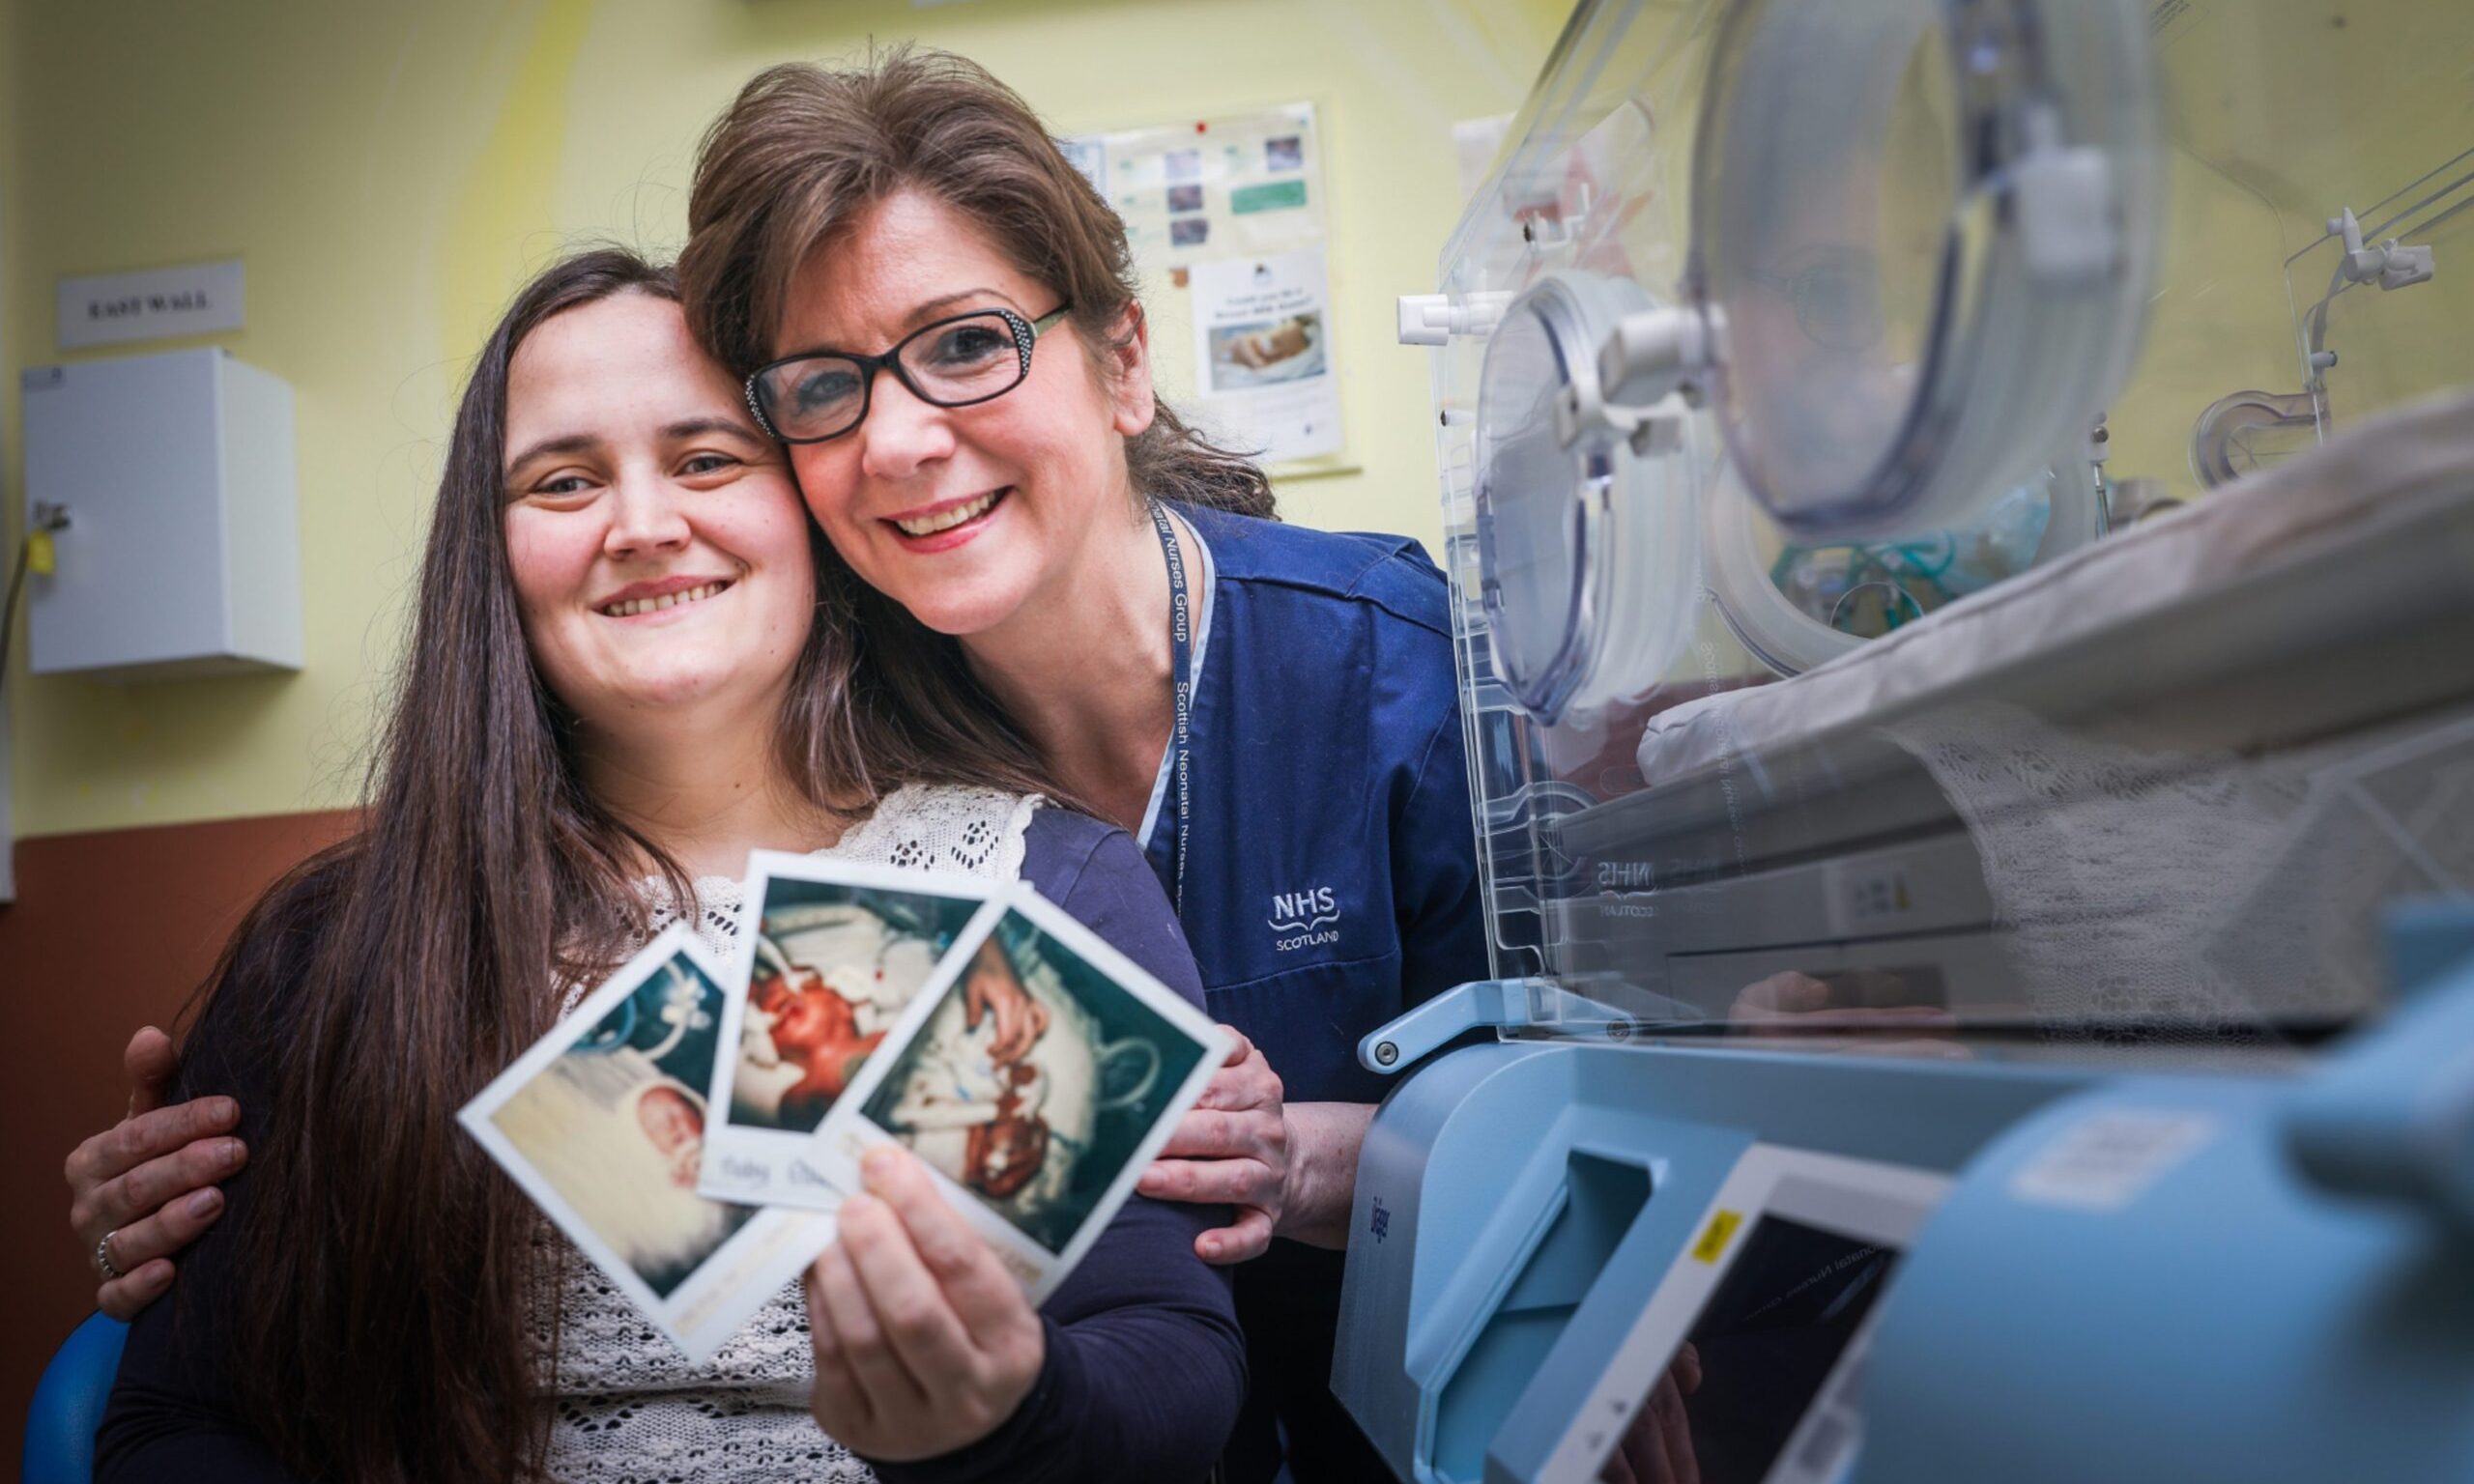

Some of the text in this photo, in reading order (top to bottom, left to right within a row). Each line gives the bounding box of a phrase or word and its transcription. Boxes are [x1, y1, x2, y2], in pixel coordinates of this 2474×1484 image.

[88, 289, 214, 321] EAST WALL
[1165, 537, 1184, 589] Nurses
[1174, 593, 1188, 642] Group
[1176, 682, 1189, 745] Scottish
[1179, 749, 1190, 820] Neonatal
[1273, 886, 1335, 920] NHS
[1276, 930, 1339, 952] SCOTLAND
